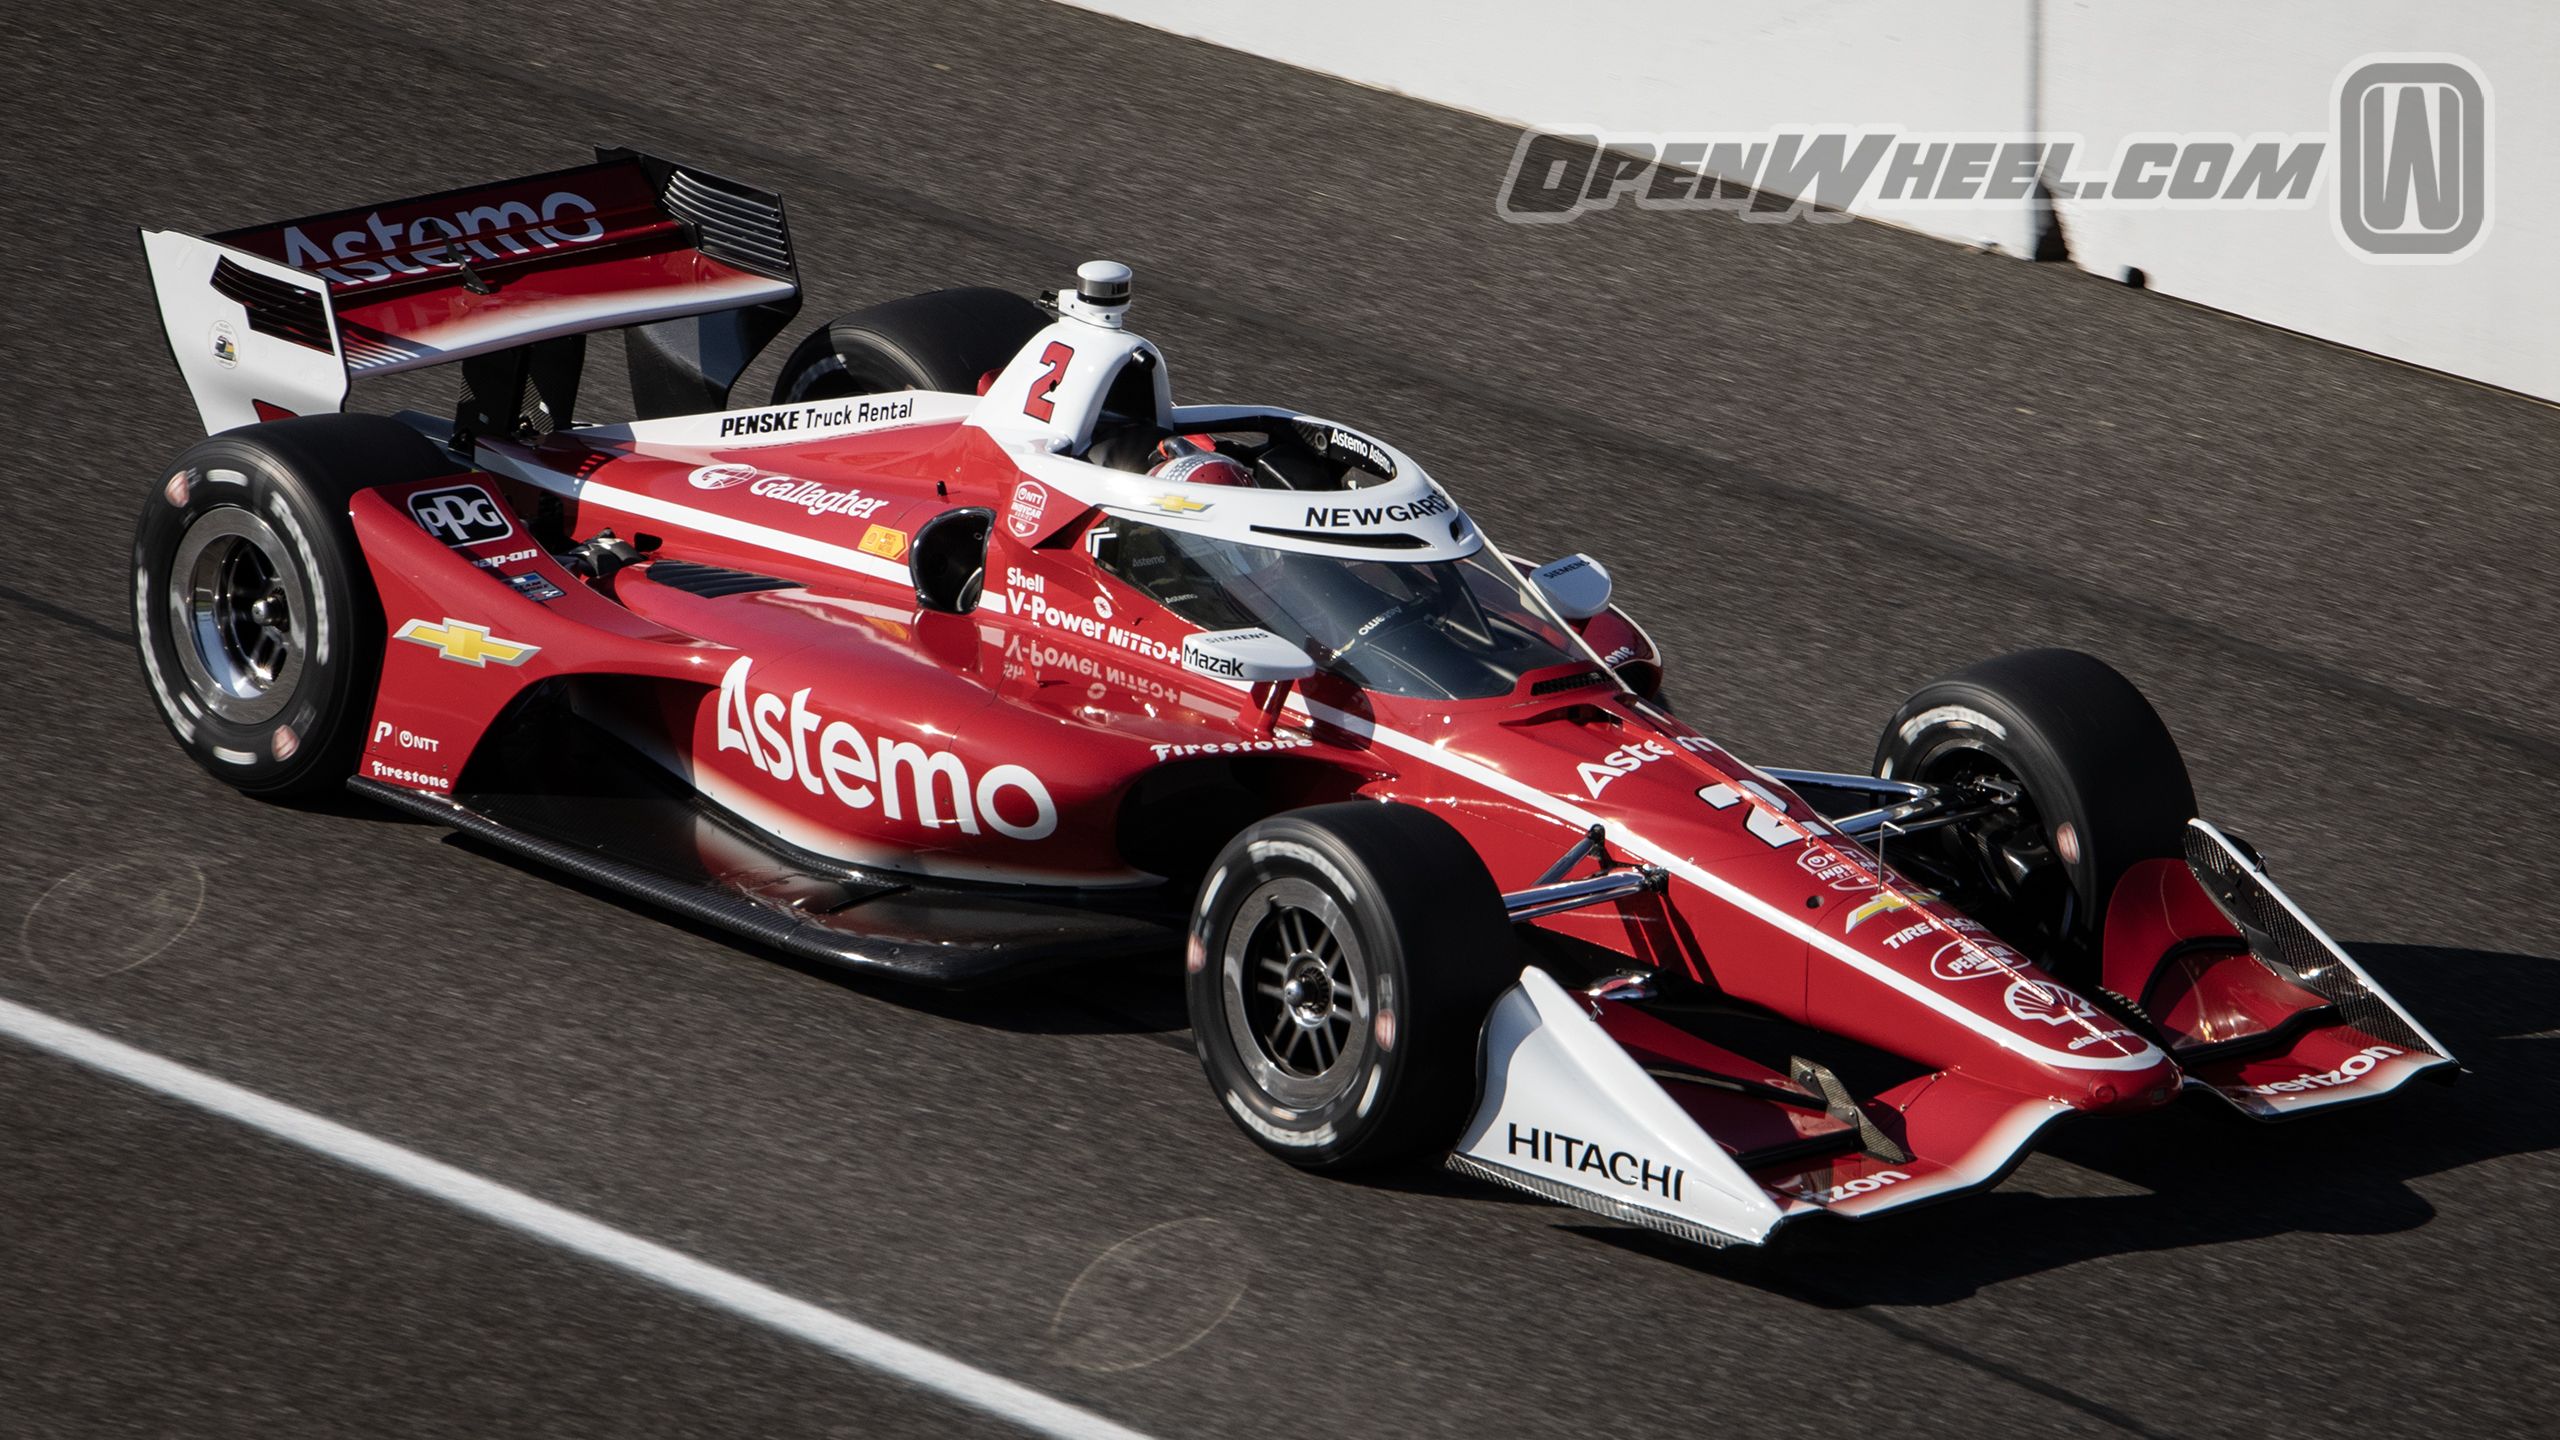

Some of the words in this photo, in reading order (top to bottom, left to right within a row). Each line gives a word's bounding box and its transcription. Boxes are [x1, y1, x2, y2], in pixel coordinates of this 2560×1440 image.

[282, 191, 605, 287] Astemo
[1022, 339, 1075, 424] 2
[719, 410, 801, 438] PENSKE
[805, 404, 852, 429] Truck
[857, 397, 914, 424] Rental
[1329, 427, 1369, 458] Astemo
[750, 475, 890, 520] Gallagher
[1305, 489, 1451, 527] NEWGARD
[416, 494, 503, 541] PPG
[1006, 566, 1045, 594] Shell
[1542, 559, 1592, 581] SIEMENS
[1006, 587, 1106, 641] V-Power
[1205, 631, 1270, 645] SIEMENS
[1183, 643, 1245, 678] Mazak
[717, 655, 1060, 841] Astemo
[1150, 738, 1315, 763] Firestone
[371, 760, 450, 789] Firestone
[1882, 921, 1934, 950] TIRE
[2254, 1045, 2404, 1096] verizon
[1508, 1122, 1686, 1203] HITACHI
